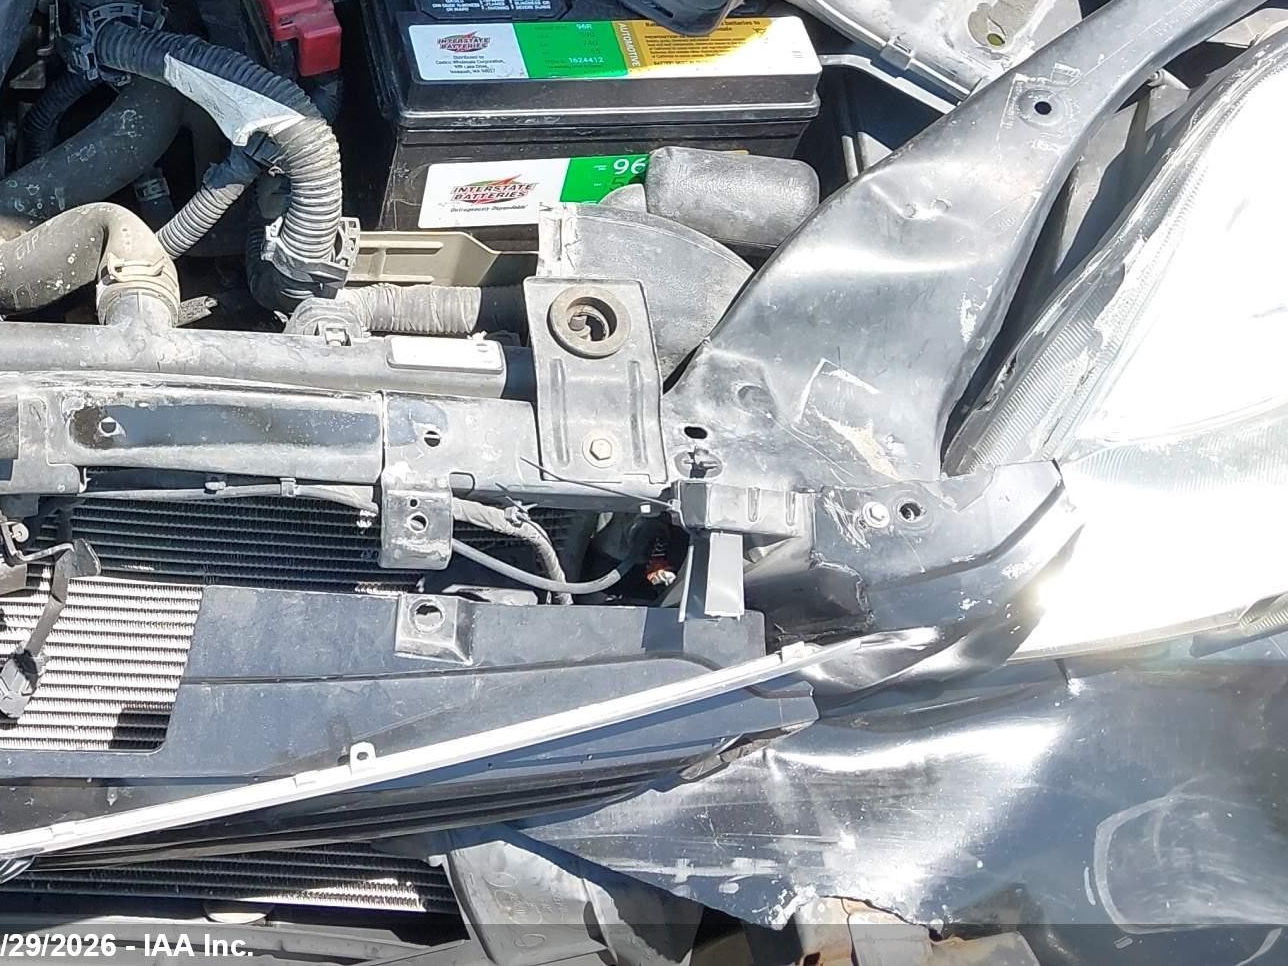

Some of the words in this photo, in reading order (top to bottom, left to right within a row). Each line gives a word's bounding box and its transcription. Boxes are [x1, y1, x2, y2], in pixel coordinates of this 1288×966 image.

[437, 36, 491, 45] INTERSTATE
[618, 22, 641, 67] AUTOMOTIVE
[568, 56, 605, 64] 1624412
[613, 157, 647, 175] 96
[452, 183, 536, 195] INTERSTATE
[453, 191, 529, 202] BATTERIES
